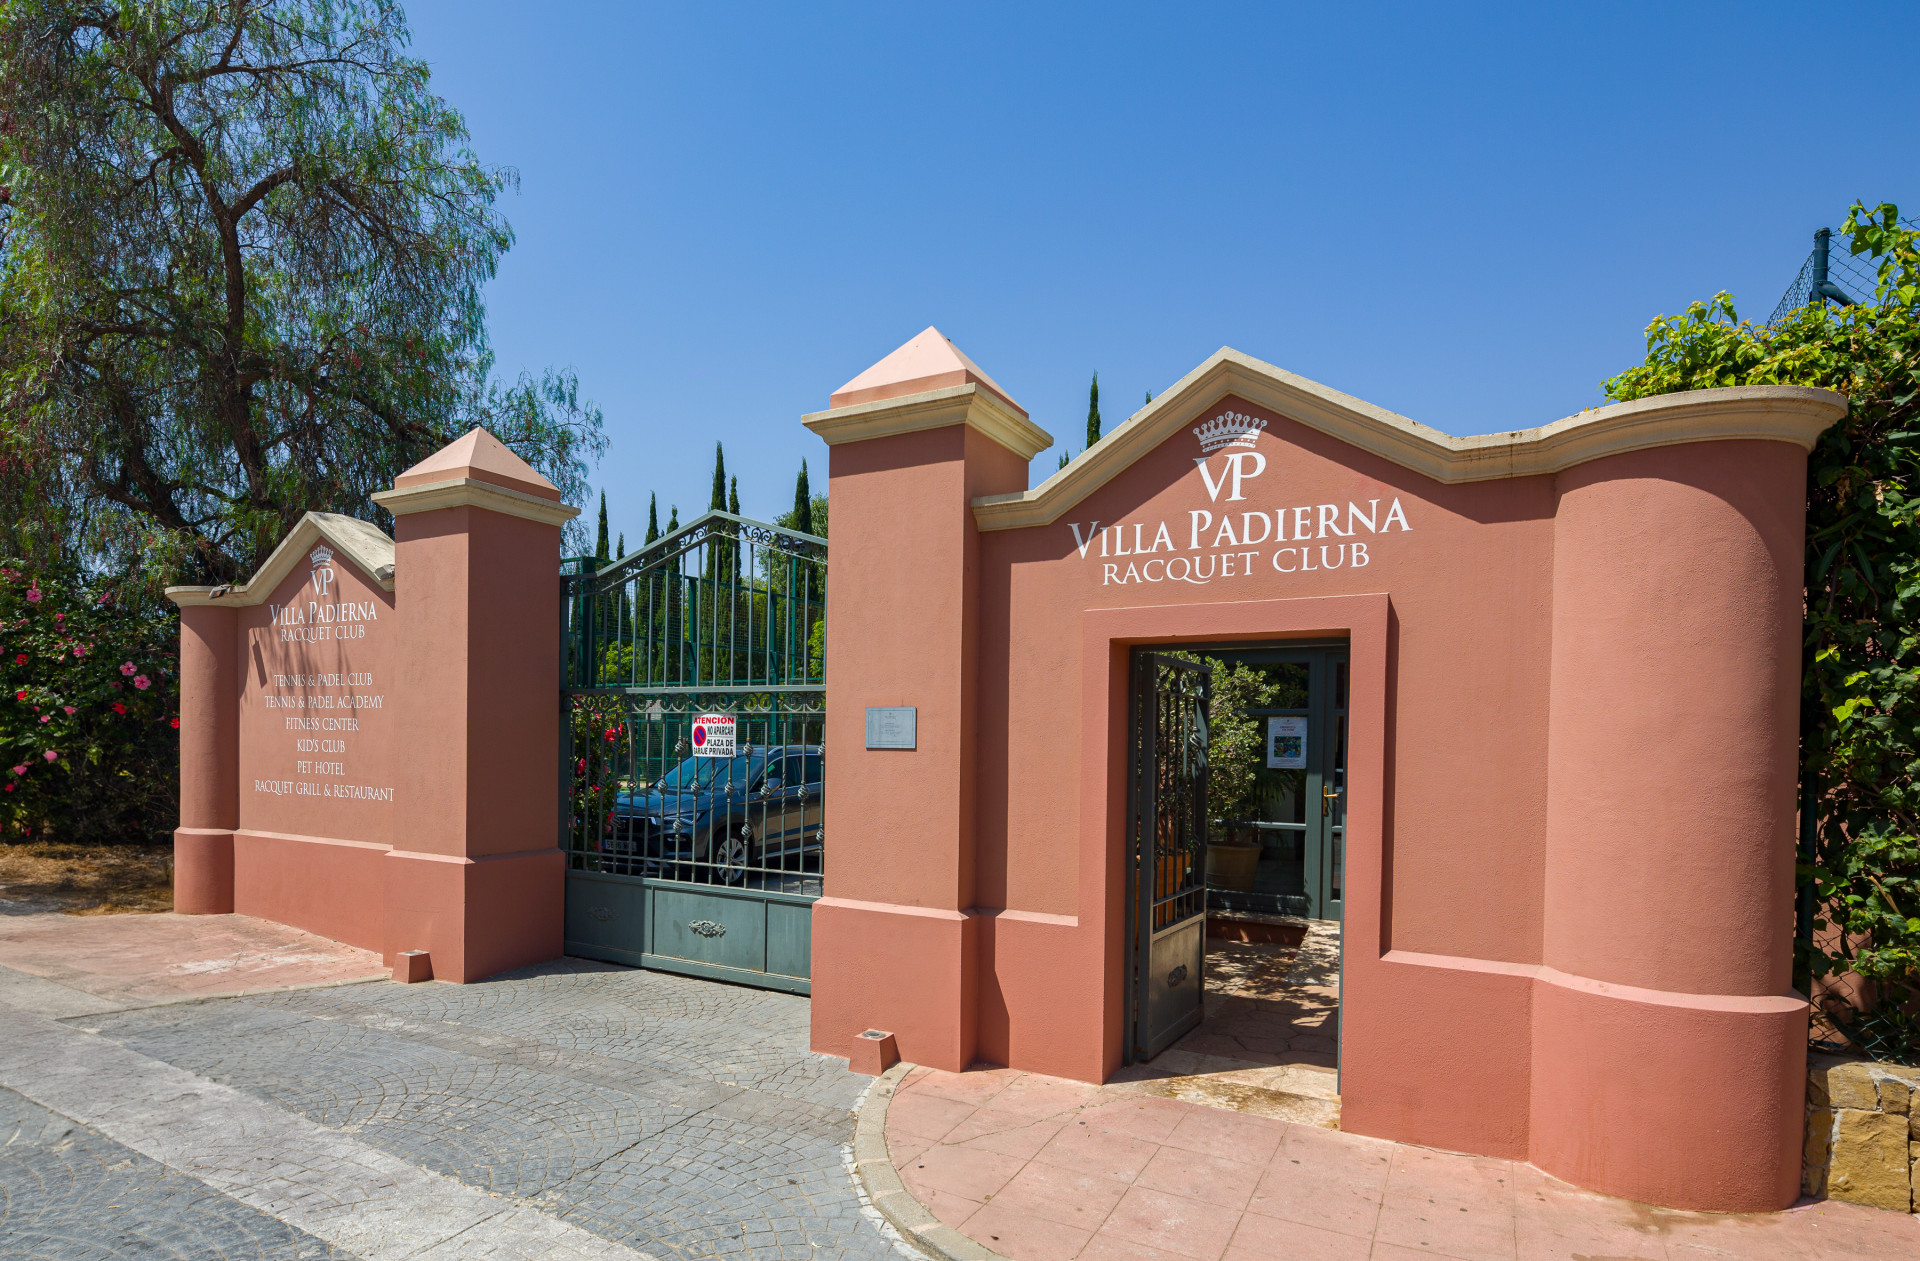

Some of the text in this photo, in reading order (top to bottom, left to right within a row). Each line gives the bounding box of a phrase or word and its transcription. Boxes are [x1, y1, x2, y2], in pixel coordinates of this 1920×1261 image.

[1193, 451, 1266, 503] VP
[1067, 496, 1413, 559] VILLA PADIERNA
[1102, 542, 1370, 586] RACQUET CLUB
[310, 567, 334, 596] VP
[270, 600, 378, 627] VILLA PADIERNA
[281, 624, 365, 644] RACQUET CLUB
[274, 672, 373, 687] TENNIS & PADEL CLUB
[264, 695, 384, 709] TENNIS & PADEL ACADEMY
[285, 717, 359, 731] FITNESS CENTER
[707, 726, 734, 736] NO APARCAR
[297, 739, 346, 753] KID'S CLUB
[706, 739, 734, 747] PLAZA DE
[708, 747, 734, 756] PRIVADA
[297, 760, 345, 776] PET HOTEL
[254, 779, 395, 802] RACQUET GRILL & RESTAURANT
